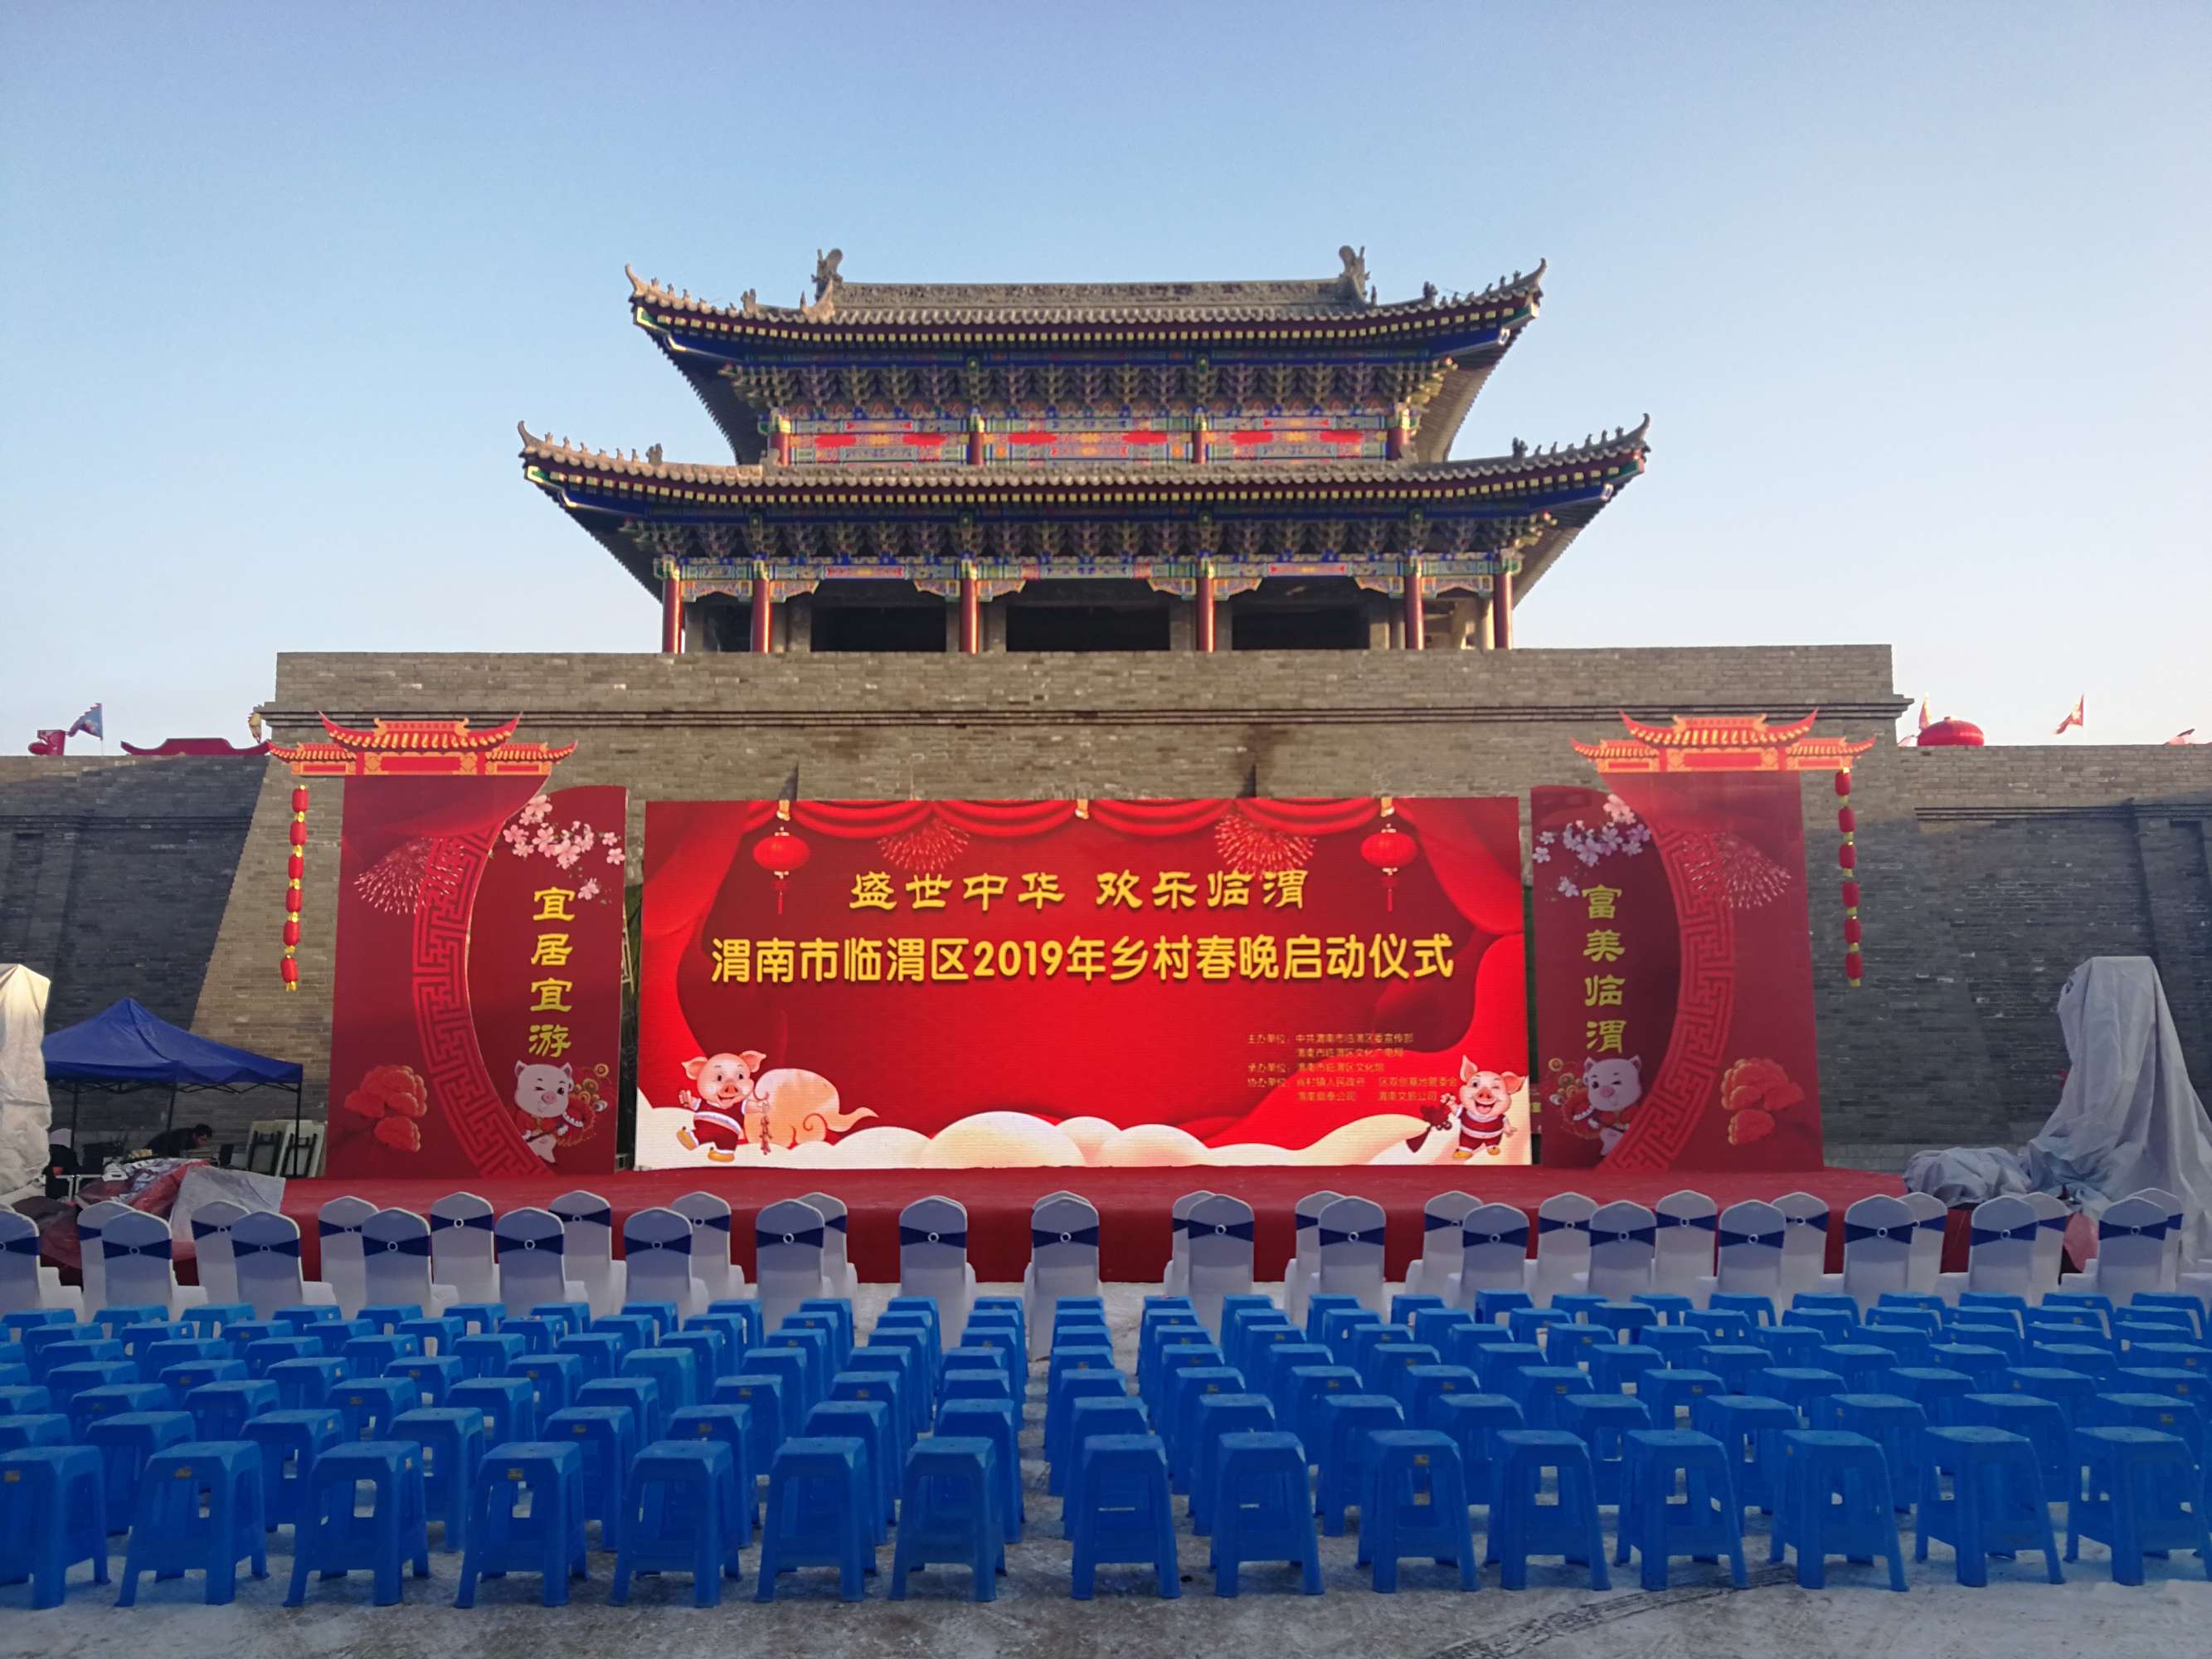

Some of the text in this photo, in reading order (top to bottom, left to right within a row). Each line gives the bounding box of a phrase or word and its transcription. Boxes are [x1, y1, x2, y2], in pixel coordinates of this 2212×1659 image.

[848, 868, 1308, 912] 盛世中华 欢乐临渭
[529, 886, 576, 1058] 宜居宜游
[712, 933, 1454, 983] 渭南市临渭区2019年乡村春晚启动仪式
[1582, 884, 1626, 1052] 富美临渭
